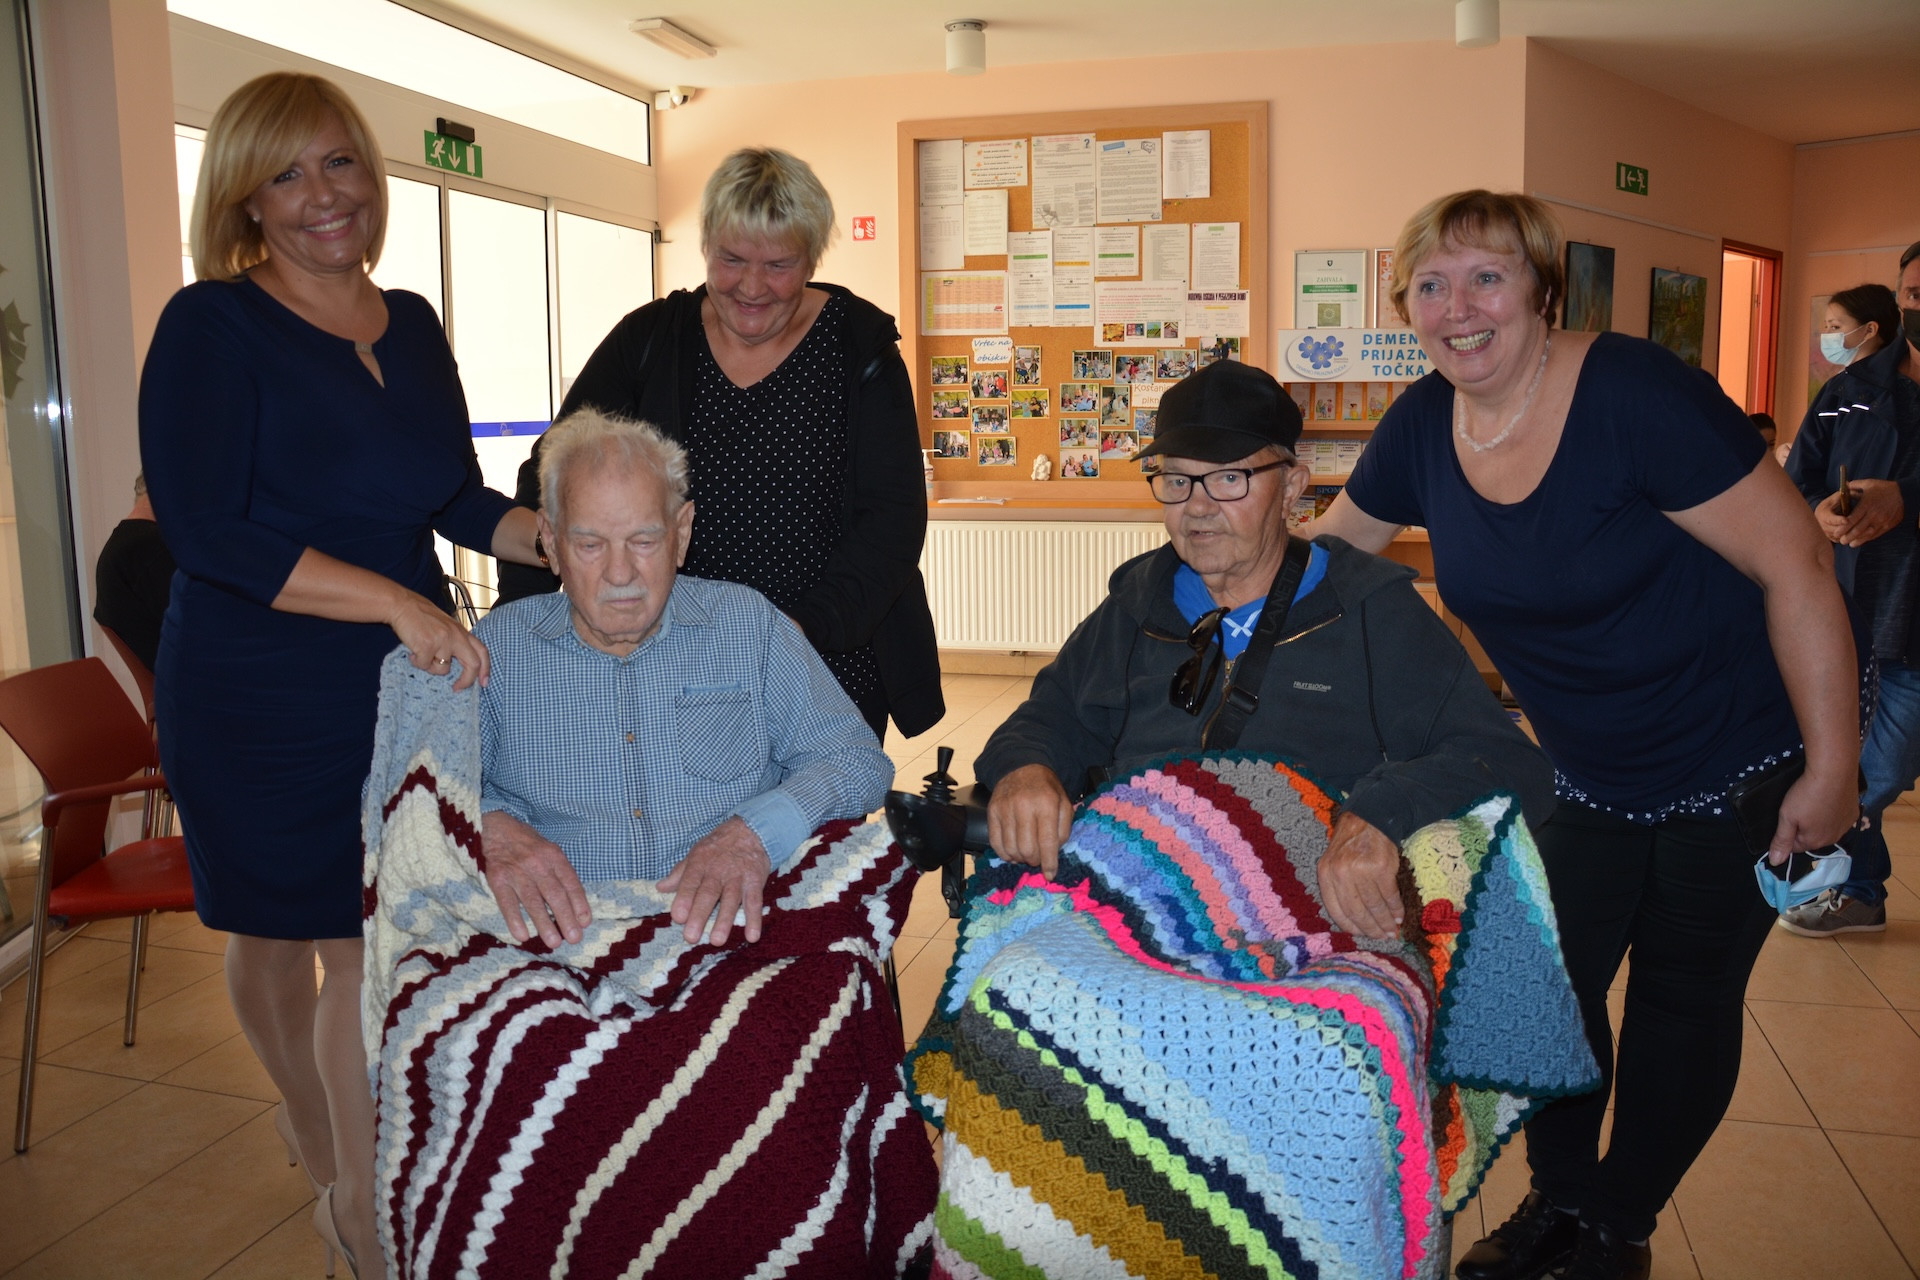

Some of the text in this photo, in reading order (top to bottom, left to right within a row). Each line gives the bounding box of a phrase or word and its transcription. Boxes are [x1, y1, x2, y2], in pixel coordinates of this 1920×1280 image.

[1363, 333, 1418, 345] DEMEN
[977, 353, 1008, 362] obisku
[1361, 349, 1428, 361] PRIJAZN
[1372, 362, 1425, 376] TOČKA
[1134, 384, 1171, 392] Kostanje
[1142, 396, 1160, 405] pikn
[1316, 486, 1342, 494] SPOM
